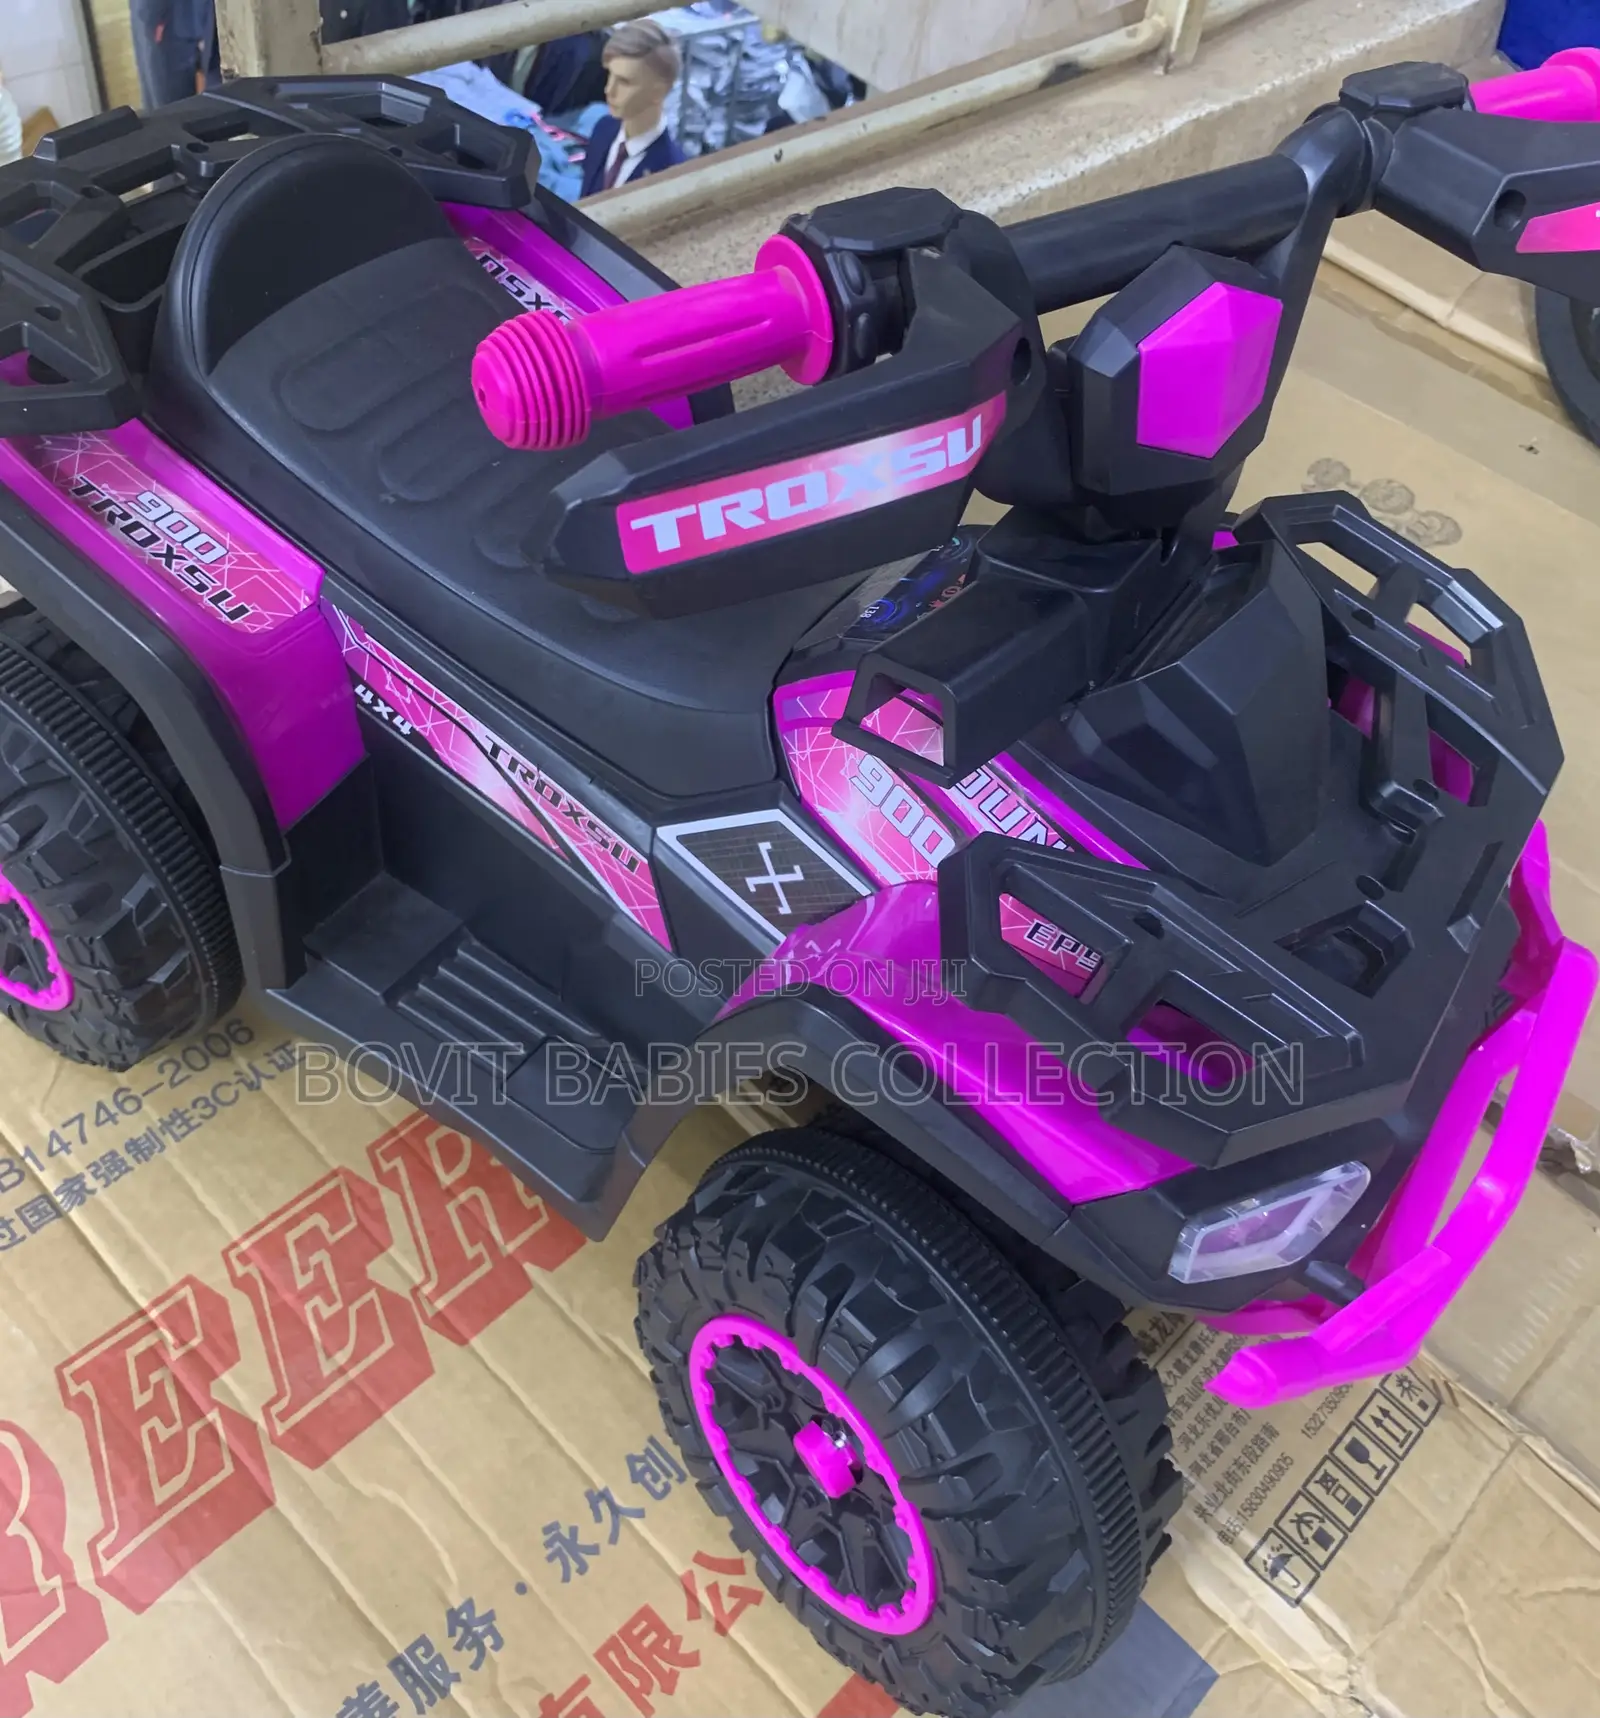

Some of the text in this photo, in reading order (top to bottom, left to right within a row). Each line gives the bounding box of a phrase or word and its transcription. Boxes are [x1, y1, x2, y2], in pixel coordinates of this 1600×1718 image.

[69, 475, 252, 624] TROXSU
[127, 490, 229, 564] 900
[630, 414, 981, 553] TROXSU
[485, 734, 641, 874] TROXSU
[849, 753, 956, 869] 900
